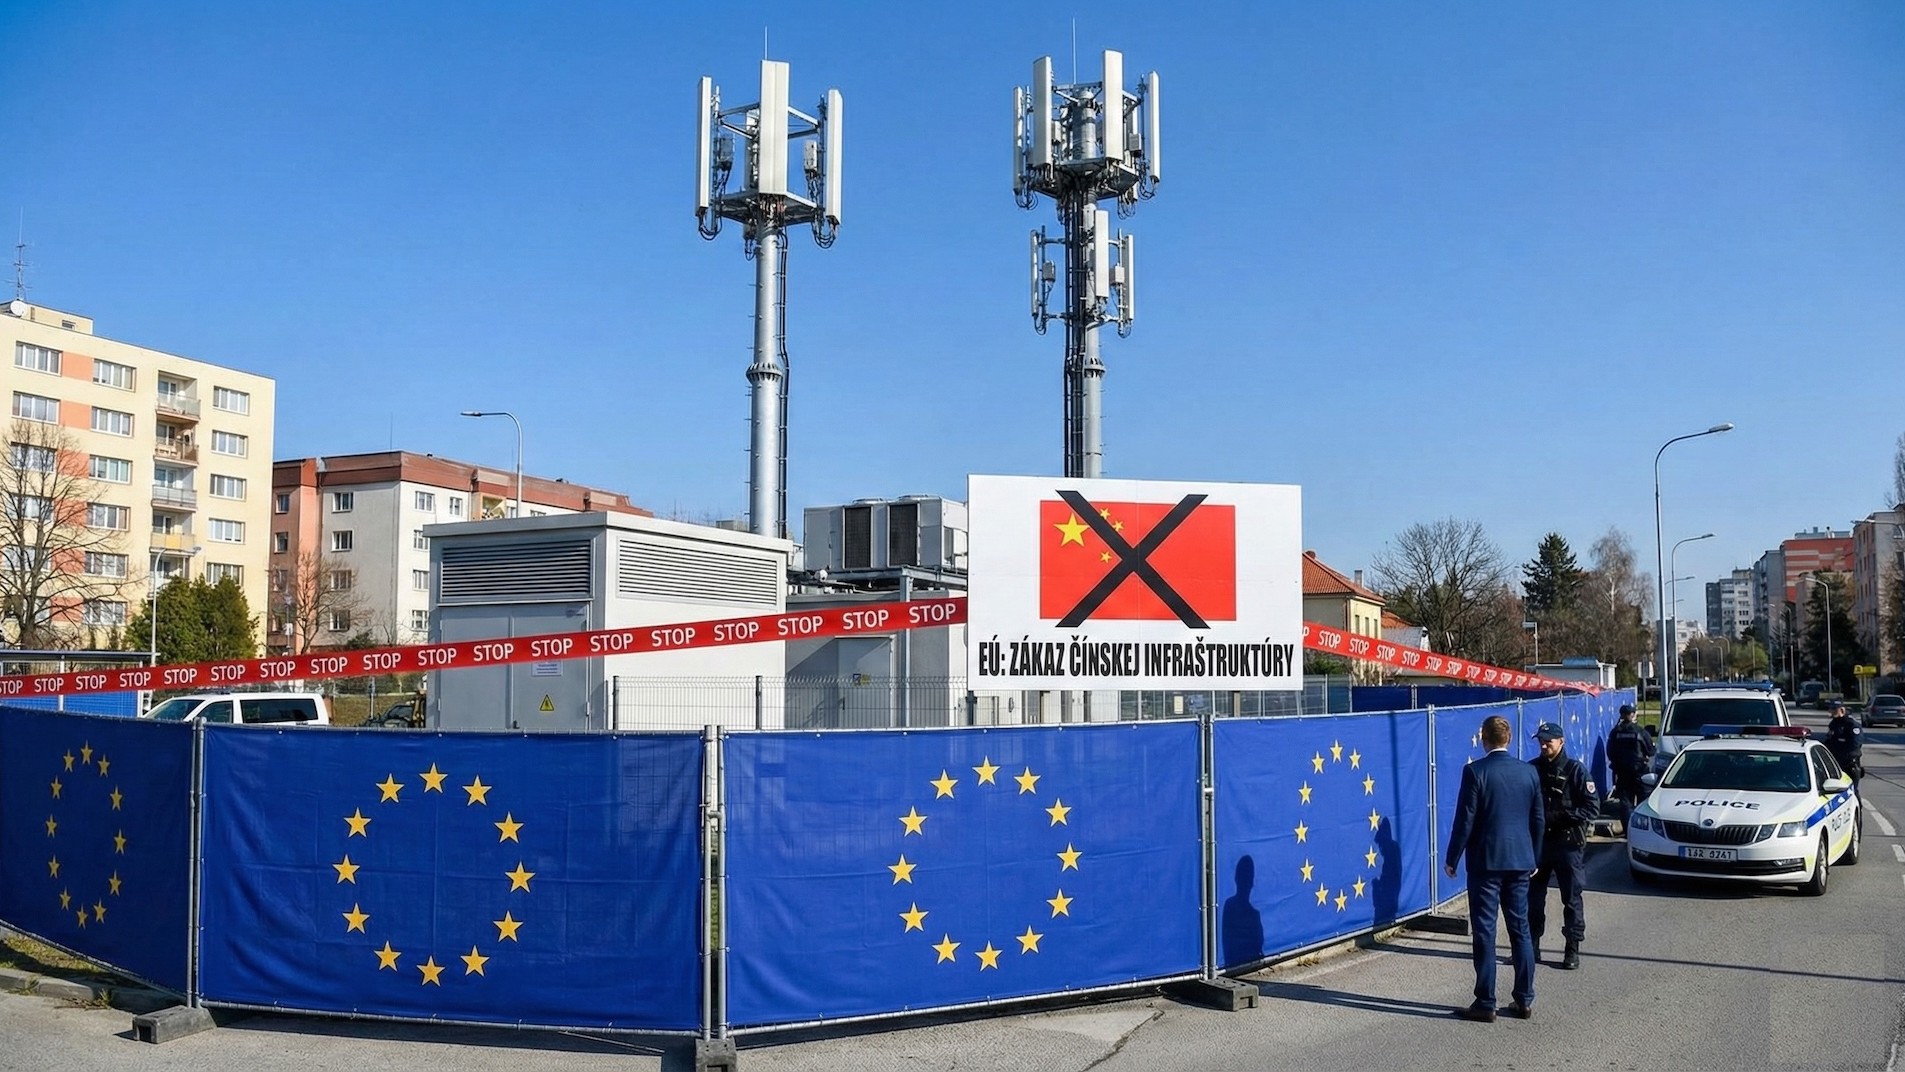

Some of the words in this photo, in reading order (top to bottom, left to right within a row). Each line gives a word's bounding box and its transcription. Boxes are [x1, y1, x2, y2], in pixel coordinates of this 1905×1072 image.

[35, 678, 63, 692] STOP
[76, 675, 106, 689] STOP
[120, 672, 151, 687] STOP
[165, 669, 197, 684] STOP
[211, 665, 245, 681] STOP
[261, 661, 295, 677] STOP
[311, 657, 347, 674] STOP
[364, 653, 400, 670] STOP
[419, 648, 456, 665] STOP
[474, 644, 513, 661] STOP
[532, 639, 572, 656] STOP
[591, 634, 633, 651] STOP
[652, 628, 695, 646] STOP
[715, 622, 759, 641] STOP
[778, 616, 822, 635] STOP
[843, 610, 888, 629] STOP
[909, 604, 955, 623] STOP
[979, 634, 1006, 677] EÚ:
[1009, 634, 1065, 677] ZÁKAZ
[1069, 635, 1140, 677] ČÍNSKEJ
[1144, 636, 1295, 677] INFRAŠTRUKTÚRY
[1319, 631, 1341, 648] STOP
[1349, 638, 1369, 654] STOP
[1376, 645, 1395, 661] STOP
[1402, 651, 1420, 666] STOP
[1674, 799, 1760, 811] POLICE
